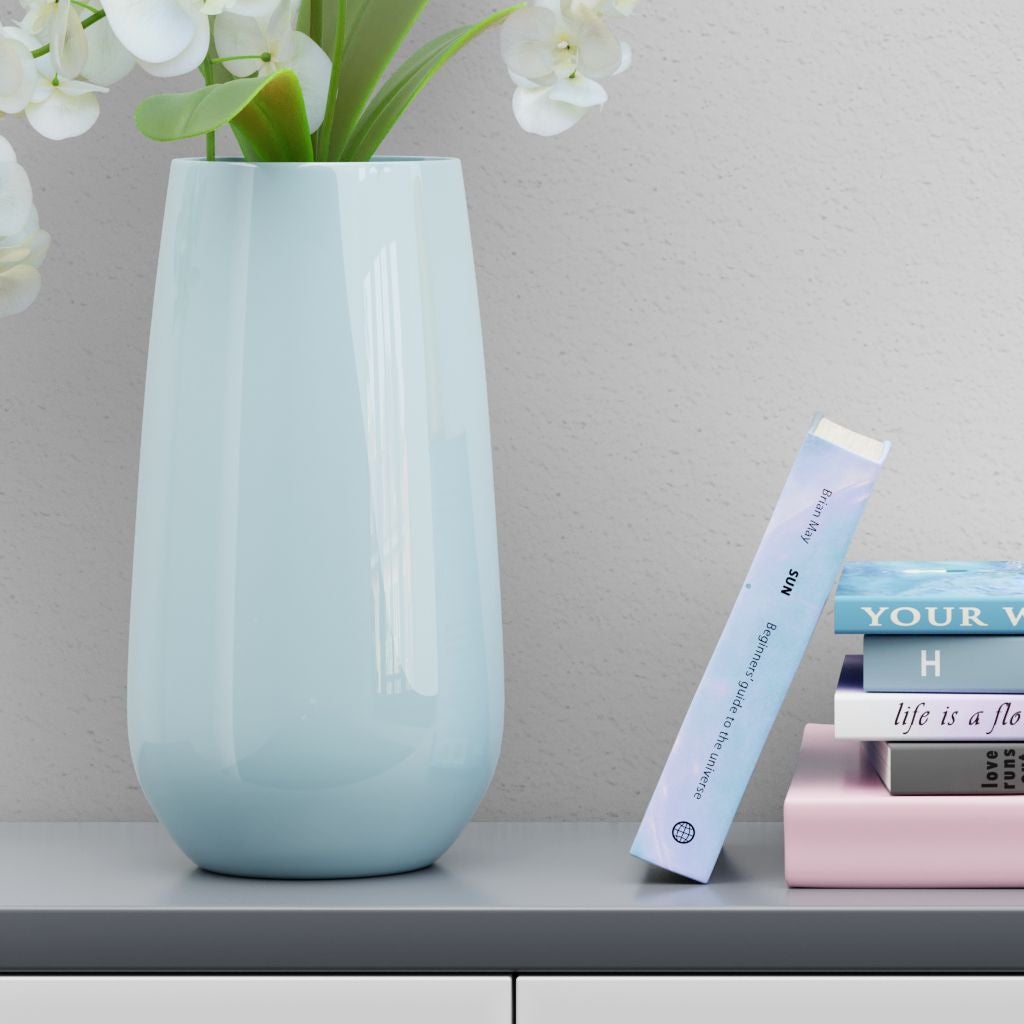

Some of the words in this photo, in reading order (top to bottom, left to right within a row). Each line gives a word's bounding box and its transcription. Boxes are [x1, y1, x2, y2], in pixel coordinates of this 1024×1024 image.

[812, 488, 832, 518] Brian
[800, 519, 819, 544] May
[781, 568, 799, 596] SUN
[860, 606, 988, 627] YOUR
[729, 680, 749, 714] guide
[723, 716, 735, 728] to
[894, 702, 930, 734] life
[941, 706, 958, 726] is
[968, 709, 984, 726] a
[714, 731, 729, 750] the
[694, 752, 719, 800] universe
[981, 750, 998, 788] love
[1004, 748, 1016, 789] runs
